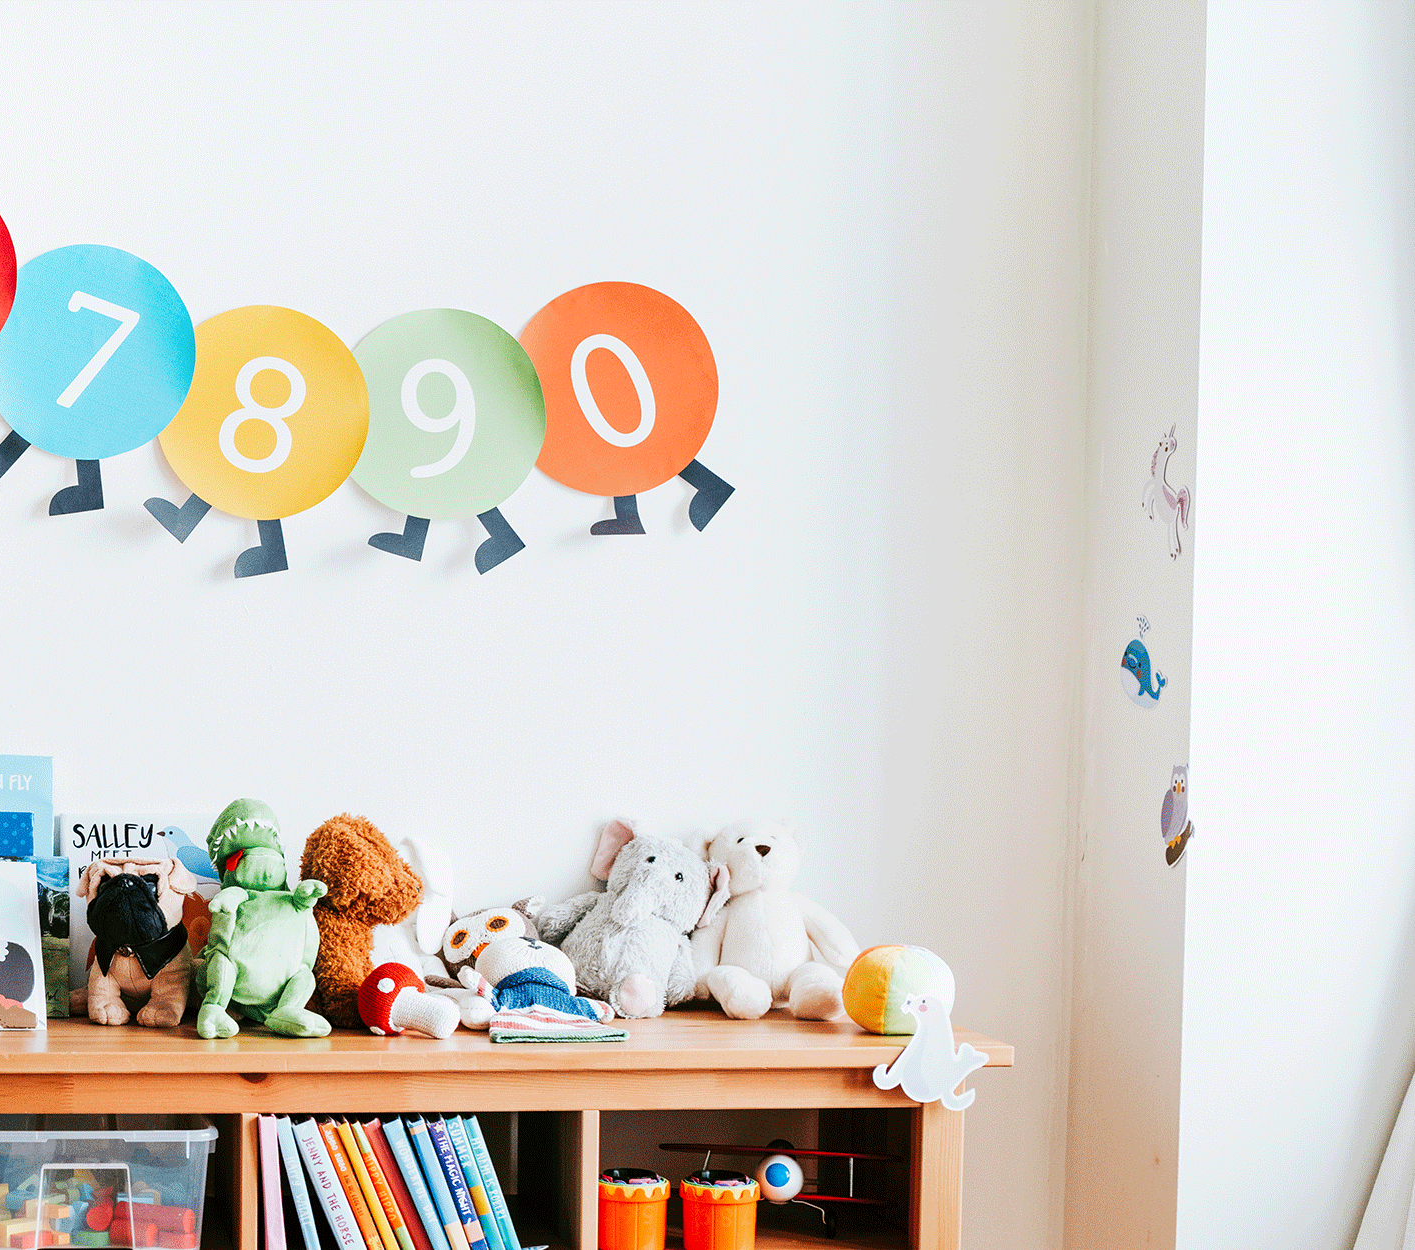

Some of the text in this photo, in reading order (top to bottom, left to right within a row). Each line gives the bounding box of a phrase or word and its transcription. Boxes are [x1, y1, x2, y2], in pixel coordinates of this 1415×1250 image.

[56, 290, 140, 409] 7
[218, 356, 306, 473] 8
[400, 358, 476, 479] 9
[570, 334, 657, 448] 0
[9, 774, 32, 791] FLY
[72, 823, 154, 849] SALLEY
[447, 1120, 472, 1169] SUMMER
[471, 1138, 507, 1220] MY NAME IS ROBERT
[301, 1136, 323, 1167] JENNY
[317, 1170, 332, 1190] AND
[326, 1192, 342, 1212] THE
[334, 1214, 355, 1246] HORSE
[365, 1152, 396, 1221] HIPPY HIPPO
[396, 1138, 439, 1223] WONDERFUL DAY
[444, 1154, 463, 1187] MAGIC
[455, 1187, 472, 1215] NIGHT
